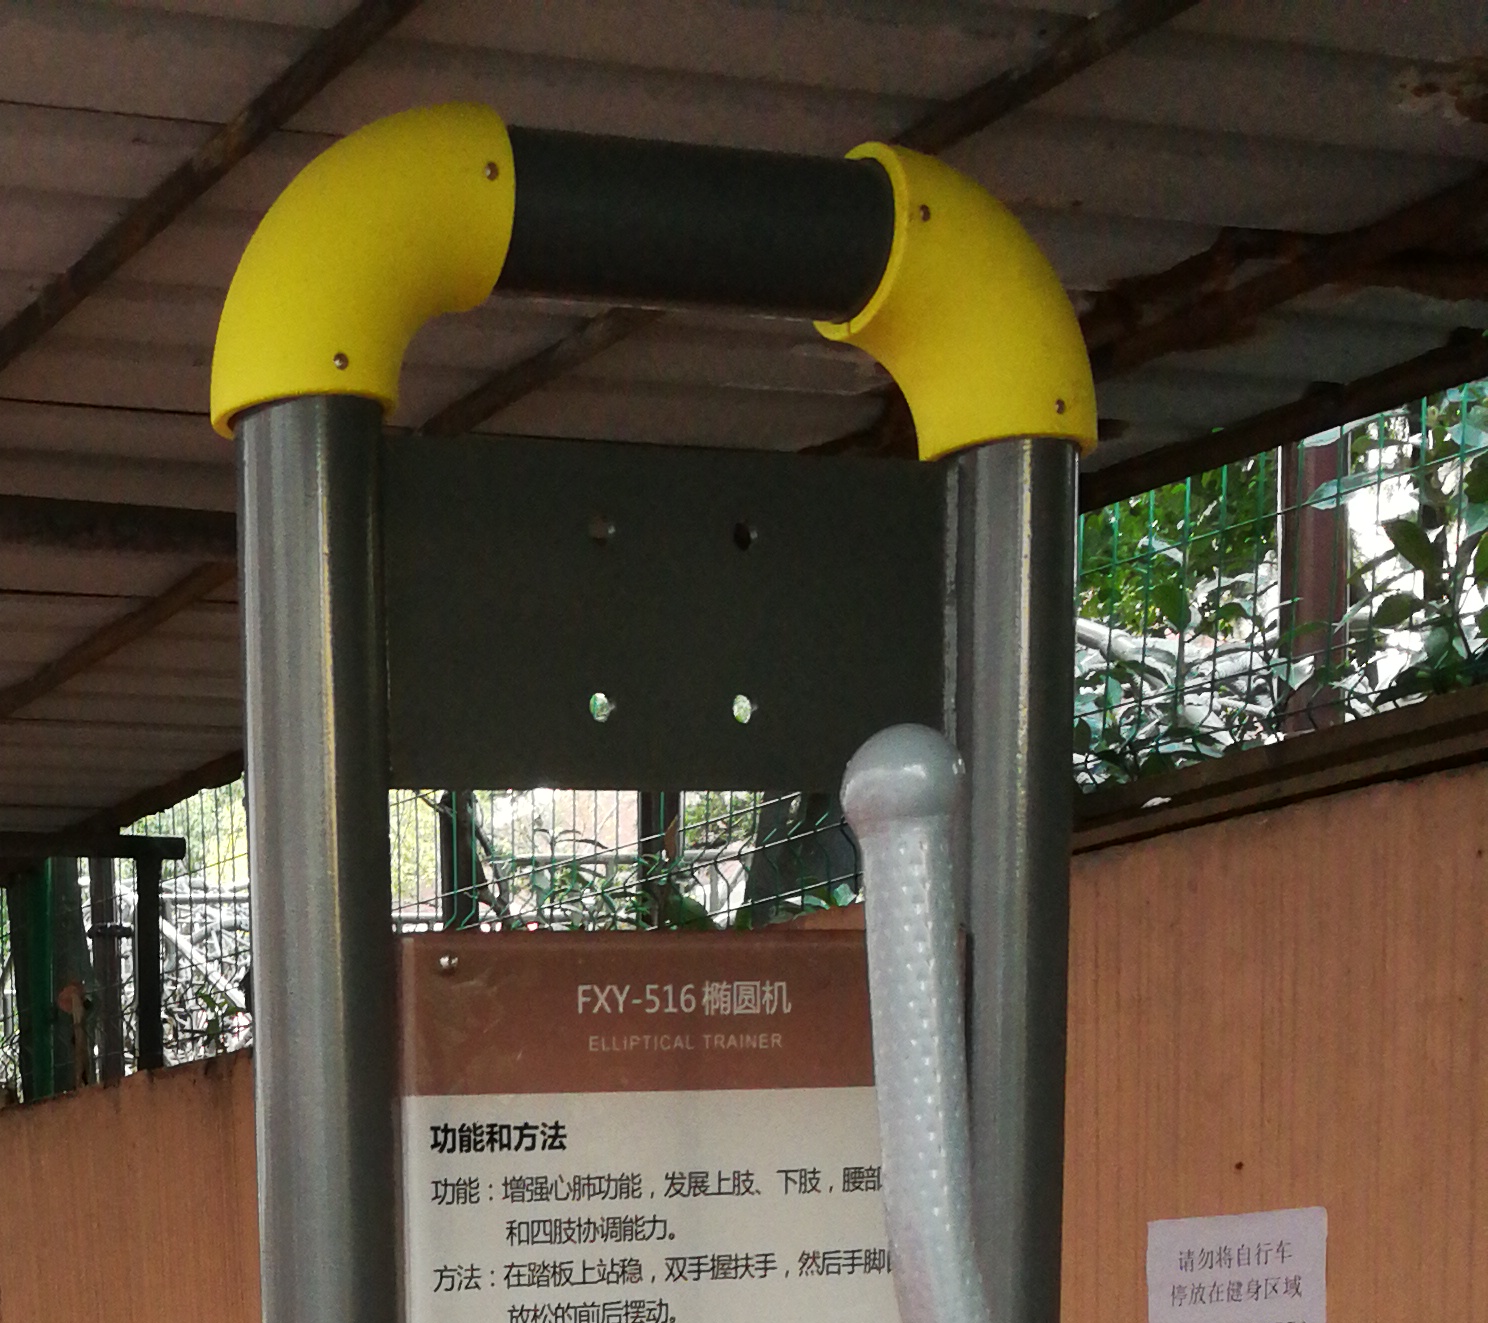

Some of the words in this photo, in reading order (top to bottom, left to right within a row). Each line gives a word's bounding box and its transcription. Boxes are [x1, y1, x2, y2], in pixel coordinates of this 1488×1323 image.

[588, 1035, 696, 1052] ELLIPTICAL
[703, 1033, 783, 1050] TRAINER
[430, 1120, 567, 1154] 功能和方法
[505, 1213, 676, 1246] 和四肢协调能力。
[433, 1247, 894, 1293] 方法：在踏板上站稳，双手握扶手，然后手脚
[1178, 1240, 1293, 1273] 请勿将自行车
[1170, 1274, 1303, 1307] 停放在健身区域
